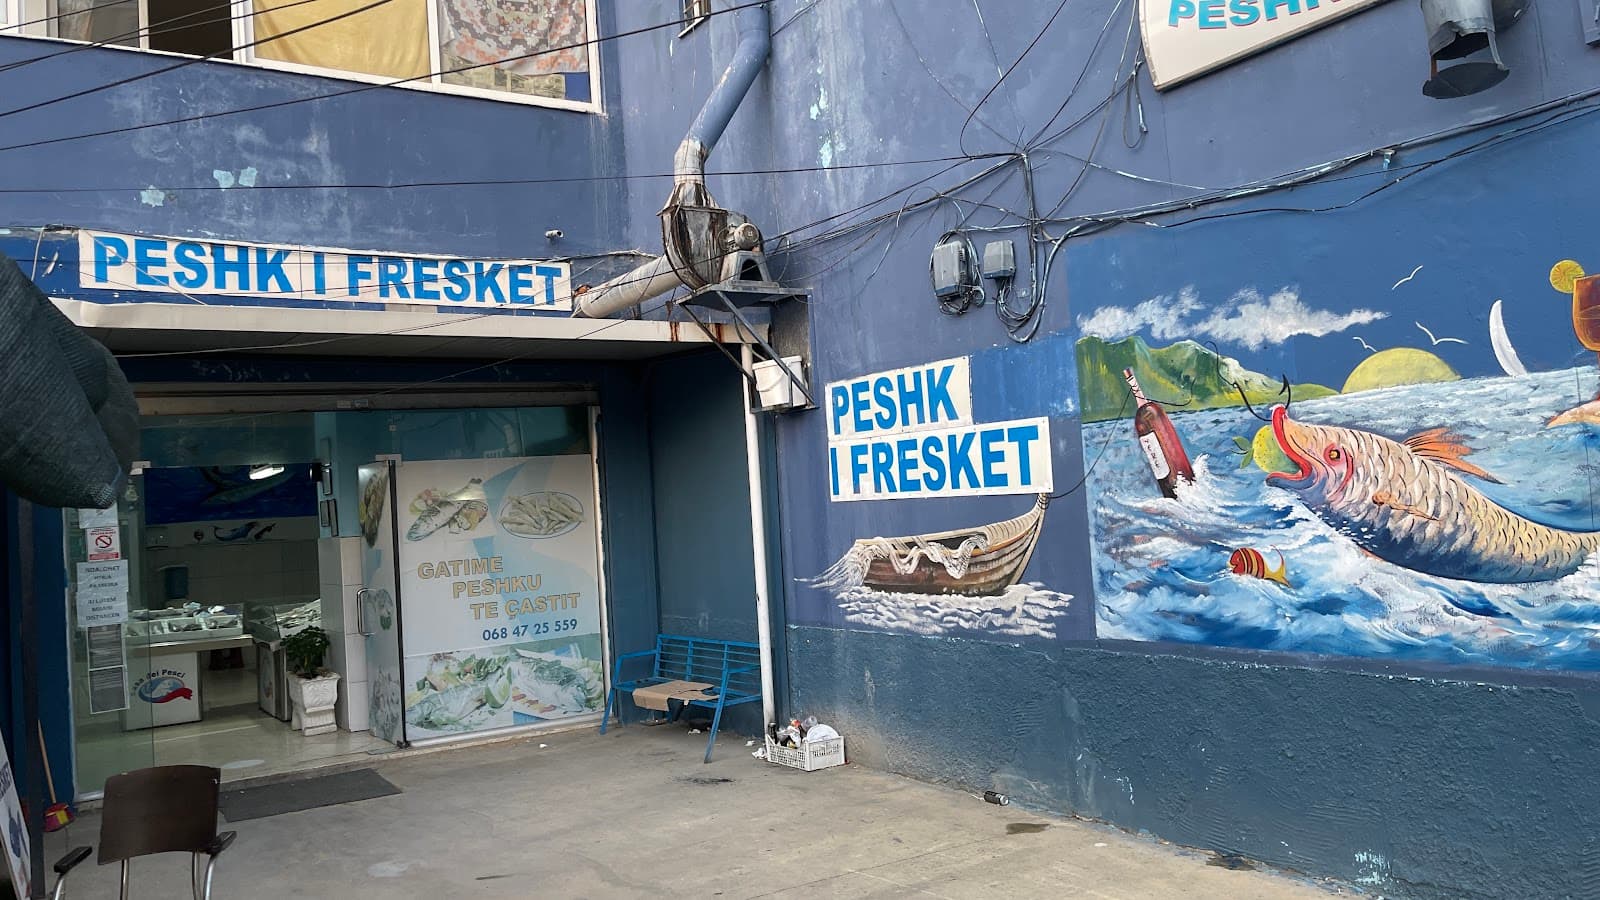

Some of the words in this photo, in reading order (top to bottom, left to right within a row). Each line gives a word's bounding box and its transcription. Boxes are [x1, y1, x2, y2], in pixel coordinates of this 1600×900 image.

[94, 236, 294, 293] PESHK
[313, 252, 326, 295] I
[348, 255, 562, 306] FRESKET
[831, 365, 959, 435] PESHK
[830, 447, 840, 496] I
[851, 425, 1039, 494] FRESKET
[417, 556, 503, 579] GATIME
[452, 574, 542, 599] PESHKU
[470, 602, 499, 620] TE
[504, 592, 581, 620] ÇASTIT
[482, 627, 508, 641] 068
[512, 625, 528, 637] 47
[534, 622, 550, 635] 25
[554, 618, 578, 632] 559
[161, 669, 186, 679] Pesci
